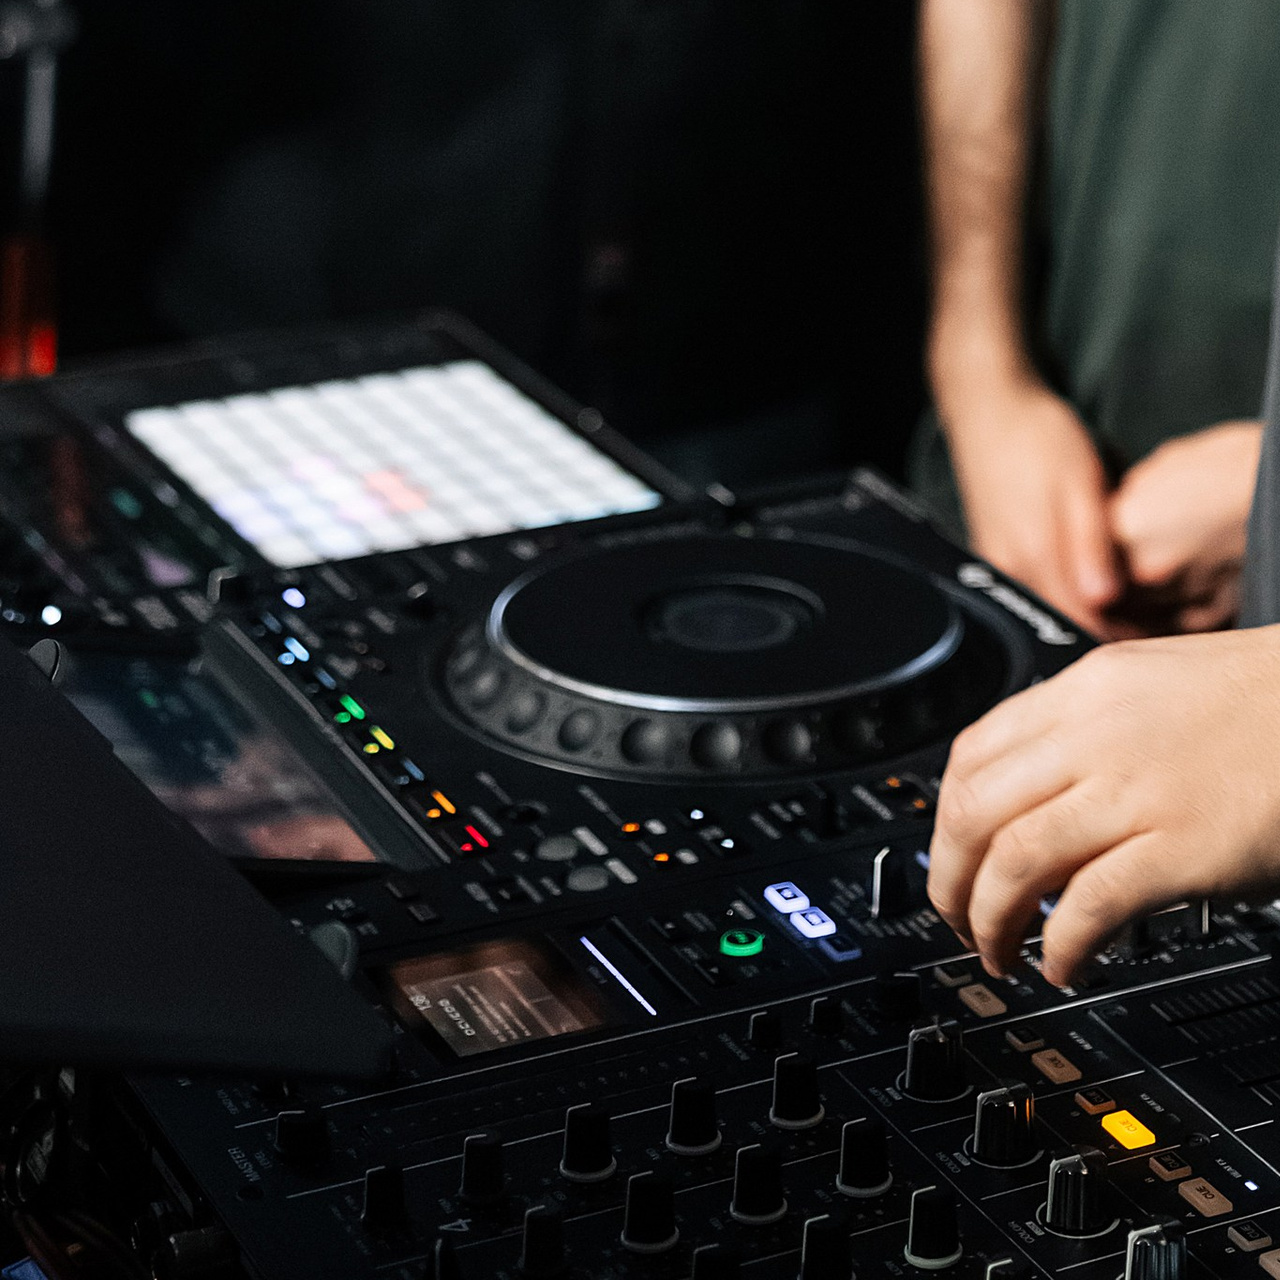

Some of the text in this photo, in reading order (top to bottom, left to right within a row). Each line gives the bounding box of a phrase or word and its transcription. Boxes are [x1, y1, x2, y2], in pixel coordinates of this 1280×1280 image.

[1119, 1118, 1138, 1131] CUE
[227, 1147, 260, 1182] MASTER
[1160, 1155, 1180, 1168] CUE
[1223, 1165, 1242, 1178] BEAT
[1195, 1185, 1215, 1199] CUE
[438, 1218, 472, 1232] 4
[1239, 1224, 1260, 1238] CUE
[1008, 1221, 1035, 1244] COLOR
